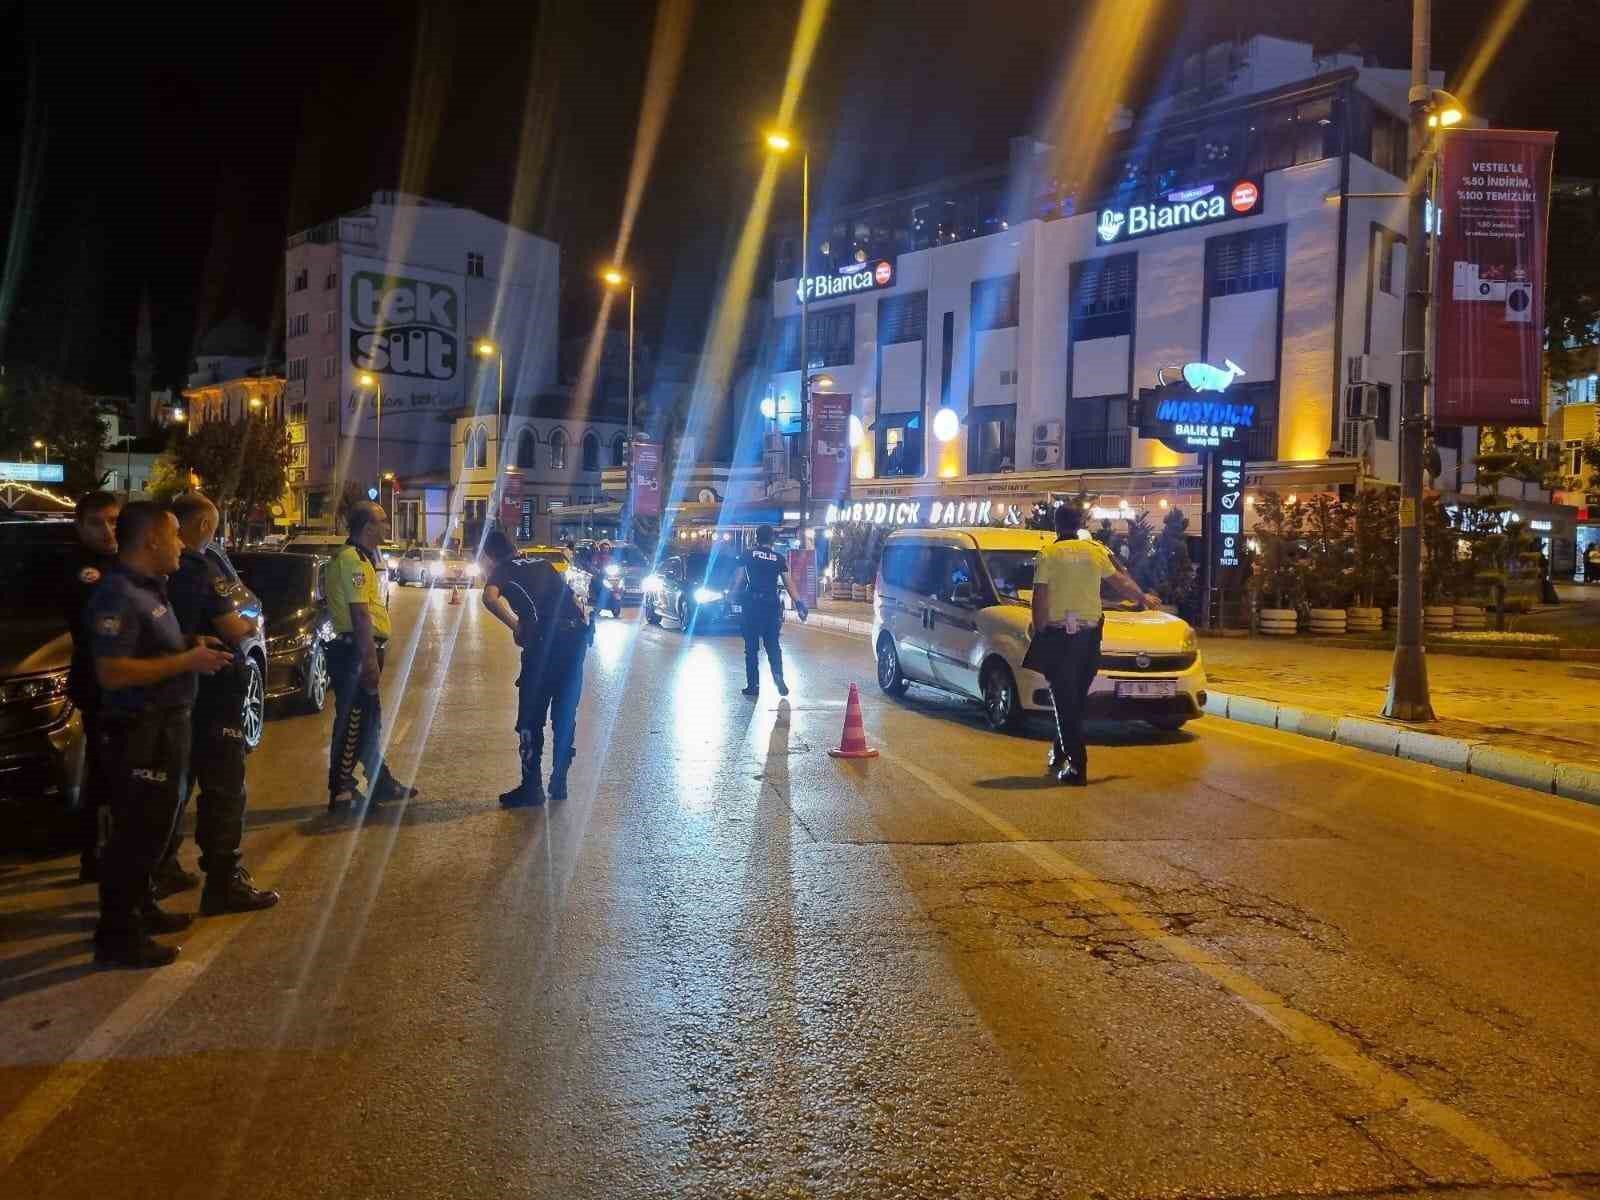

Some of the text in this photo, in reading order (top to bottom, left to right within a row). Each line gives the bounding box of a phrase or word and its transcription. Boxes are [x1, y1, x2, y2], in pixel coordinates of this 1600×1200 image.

[1472, 162, 1524, 174] VESTEL'LE
[1462, 176, 1485, 187] %50
[1457, 190, 1483, 201] %100
[1128, 195, 1226, 235] Bianca
[815, 271, 874, 298] Bianca
[357, 278, 452, 327] tek
[356, 329, 453, 380] süt
[1175, 424, 1236, 438] BALIK & ET
